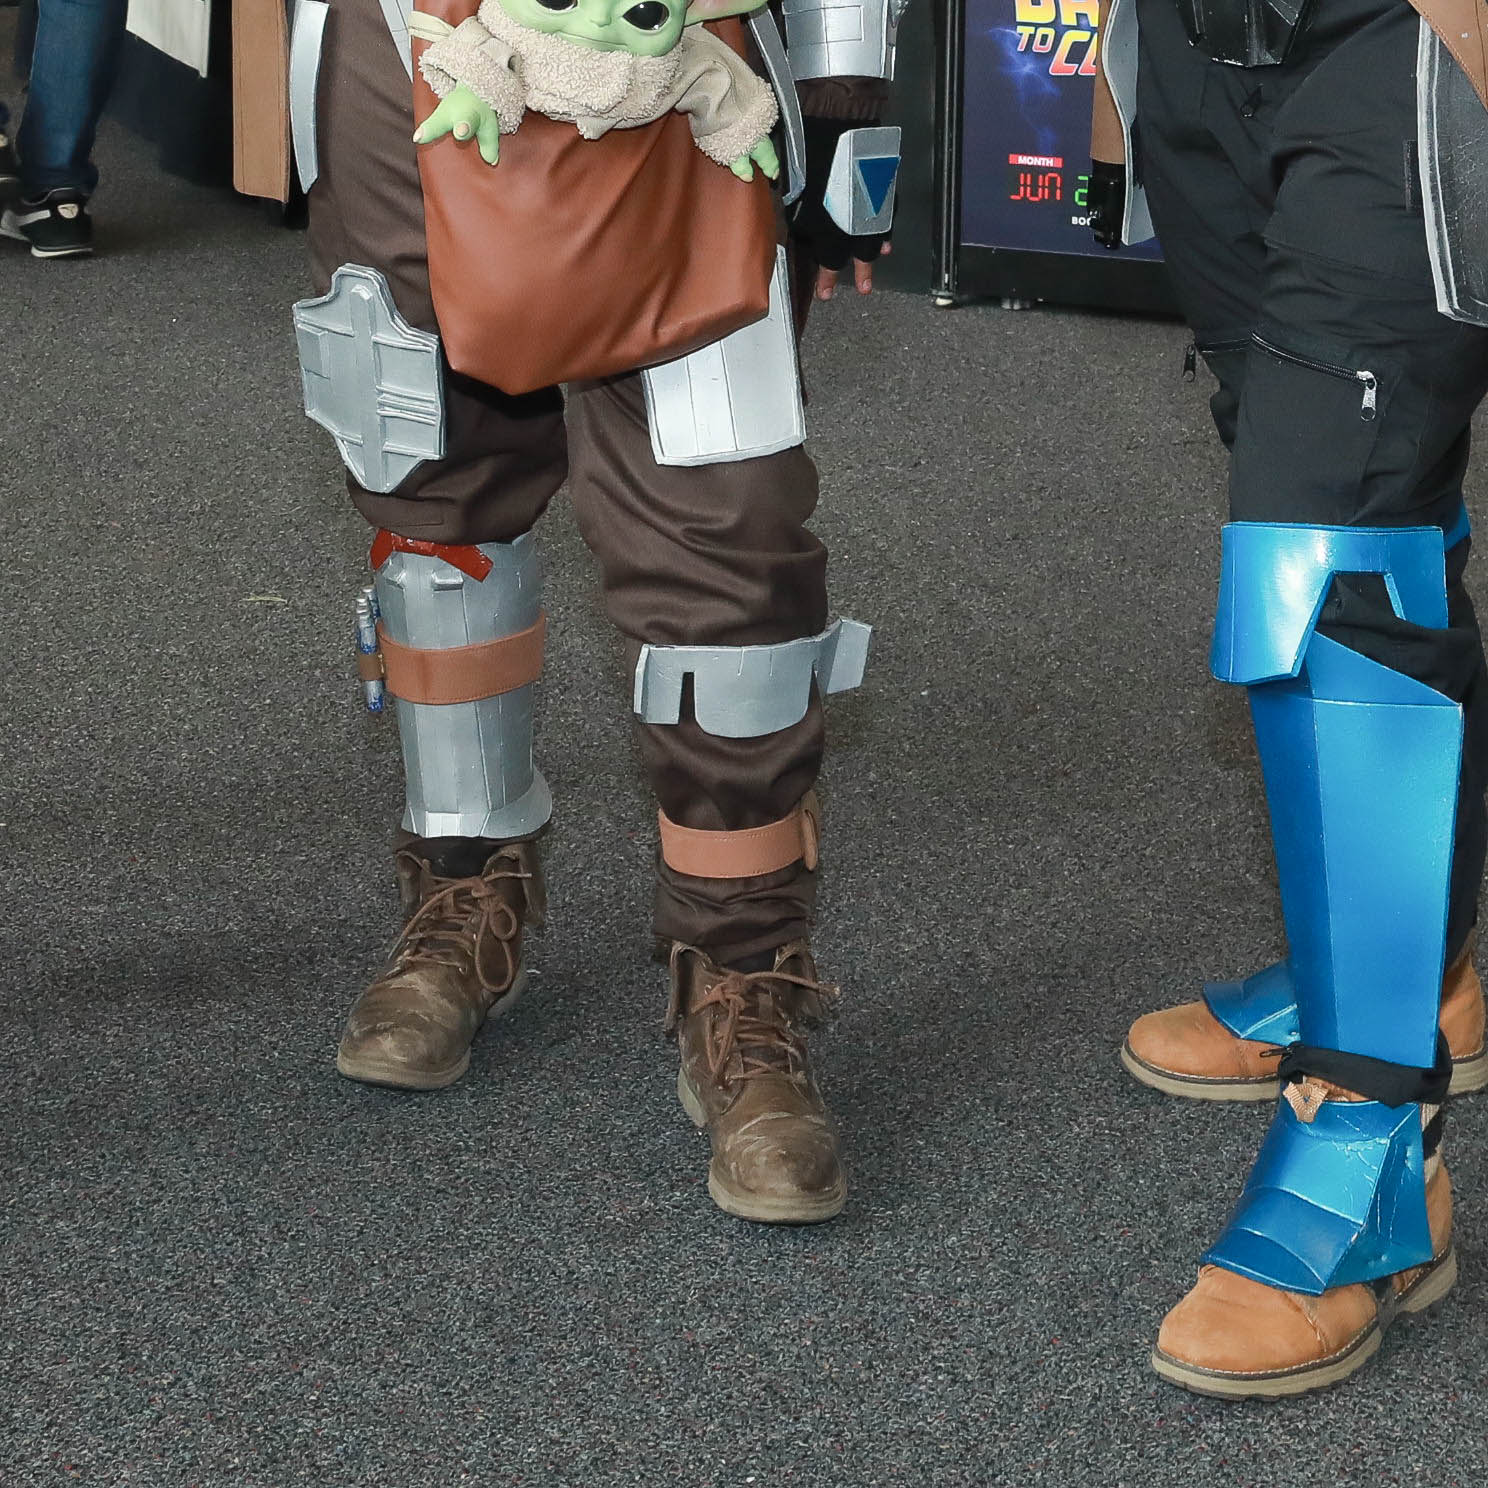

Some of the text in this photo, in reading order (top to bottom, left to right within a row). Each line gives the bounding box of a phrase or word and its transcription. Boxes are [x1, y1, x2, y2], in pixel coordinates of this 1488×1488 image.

[1016, 25, 1055, 53] TO
[1017, 155, 1053, 167] MONTH
[1010, 172, 1061, 201] JUN
